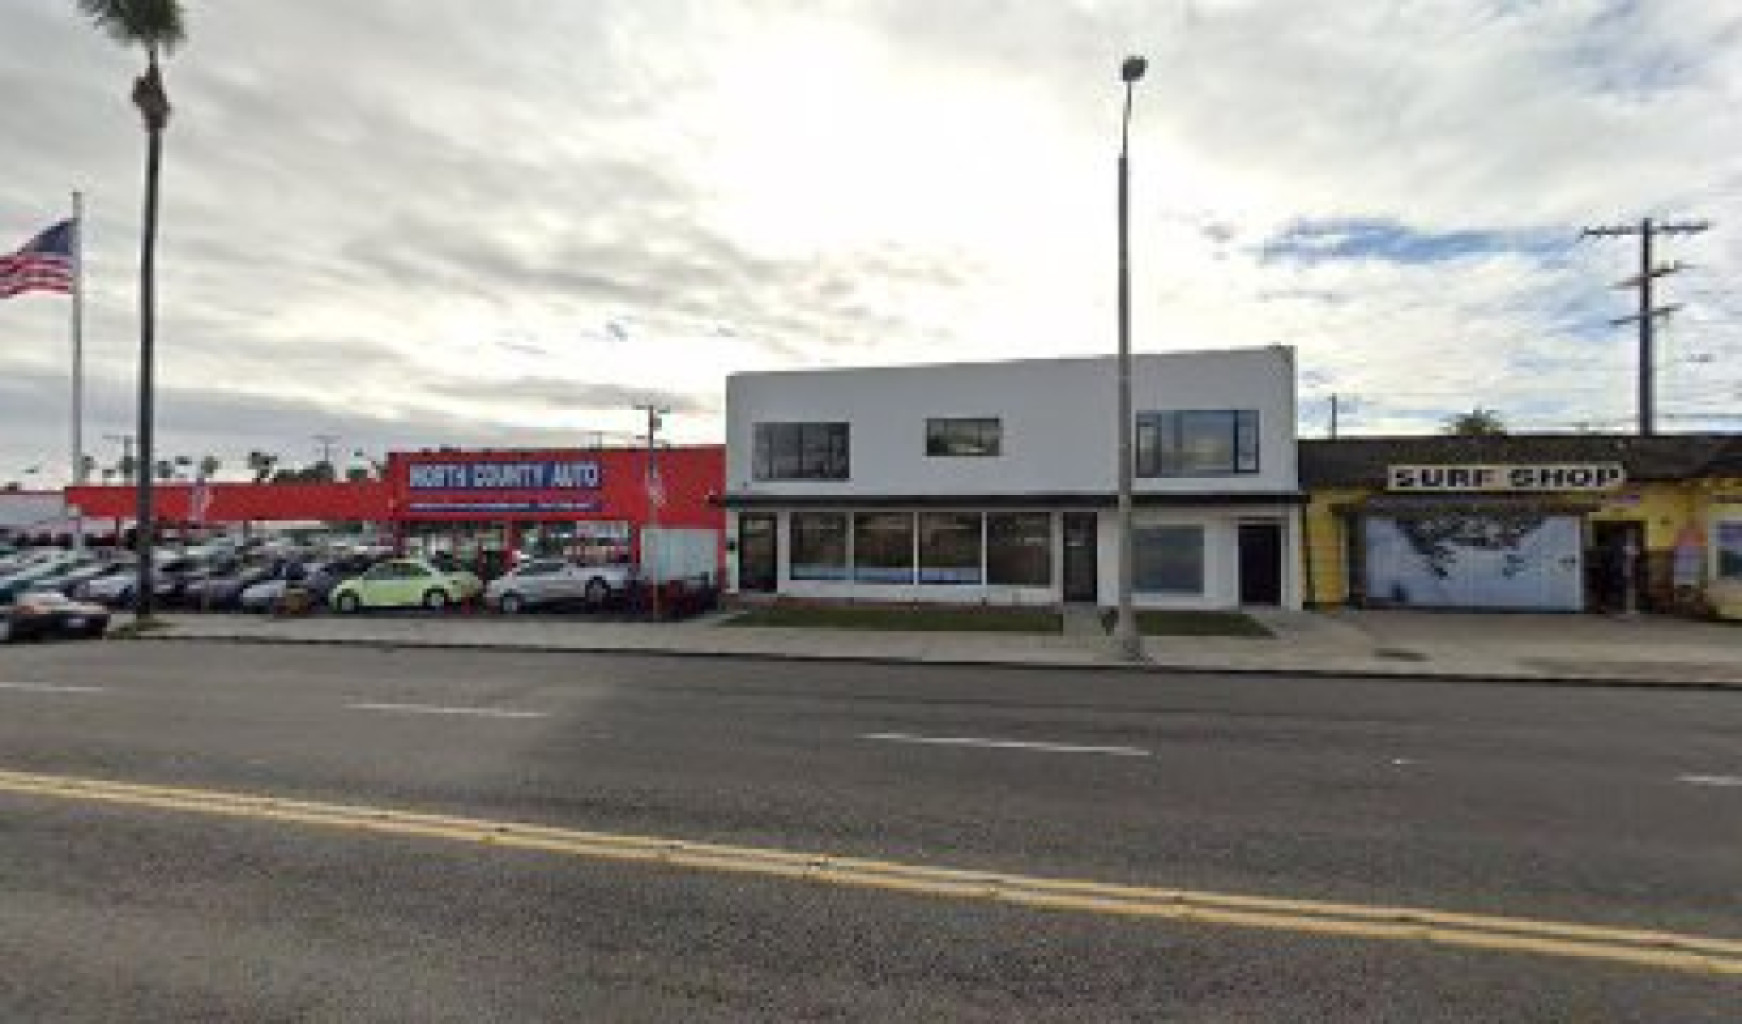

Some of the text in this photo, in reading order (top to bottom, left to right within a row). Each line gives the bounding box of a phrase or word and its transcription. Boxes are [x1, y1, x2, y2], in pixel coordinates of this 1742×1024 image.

[410, 463, 598, 488] NORTH COUNTY AUTO
[1395, 468, 1619, 488] SURF SHOP
